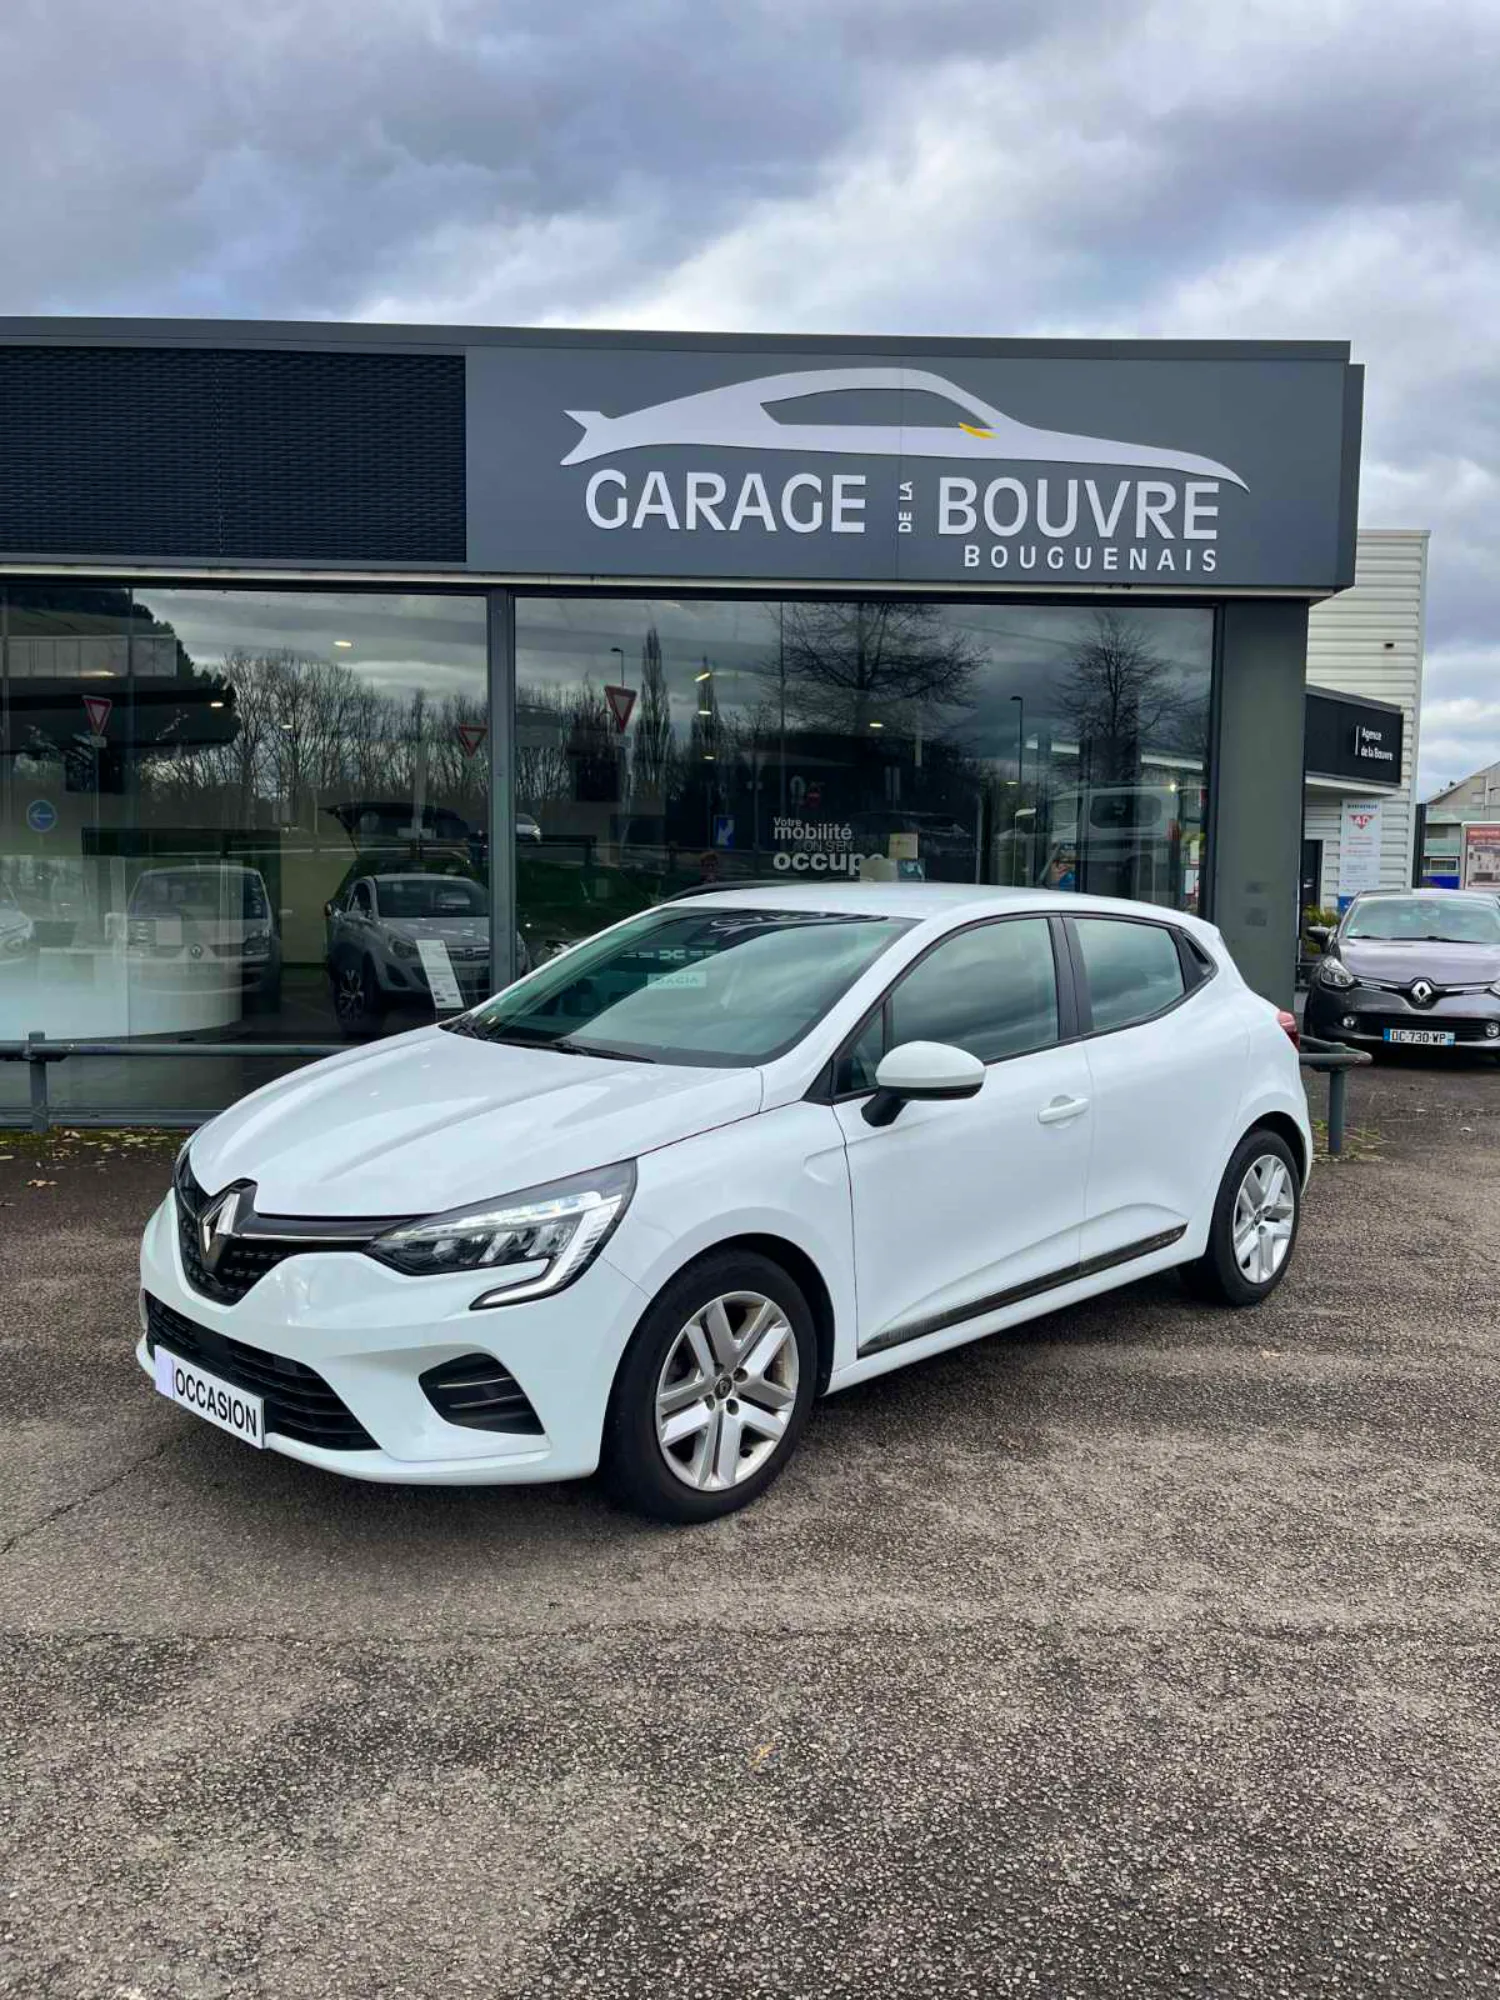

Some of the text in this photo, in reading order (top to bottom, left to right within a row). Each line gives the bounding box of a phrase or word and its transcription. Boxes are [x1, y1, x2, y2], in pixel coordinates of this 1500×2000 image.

[585, 469, 1220, 540] GARAGE DE LA BOUVRE
[964, 545, 1217, 572] BOUGUENAIS
[1361, 727, 1382, 741] Agence
[774, 817, 801, 826] Votre
[774, 823, 852, 840] mobilité
[175, 1368, 258, 1438] OCCASION
